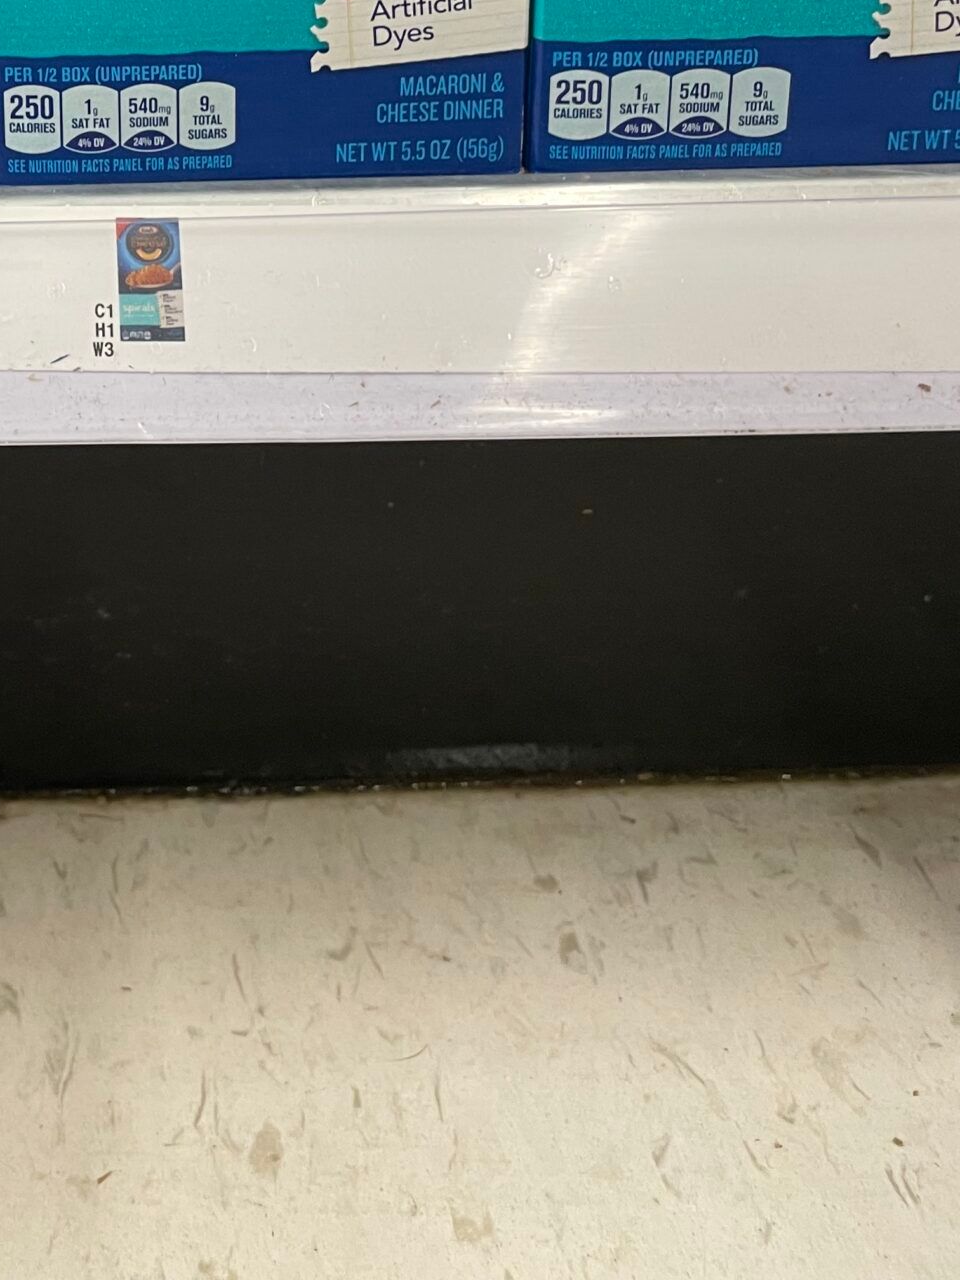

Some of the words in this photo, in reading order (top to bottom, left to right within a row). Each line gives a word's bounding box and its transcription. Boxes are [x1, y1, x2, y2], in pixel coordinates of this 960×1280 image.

[95, 304, 113, 318] C1
[96, 323, 114, 337] H1
[93, 342, 114, 356] W3
